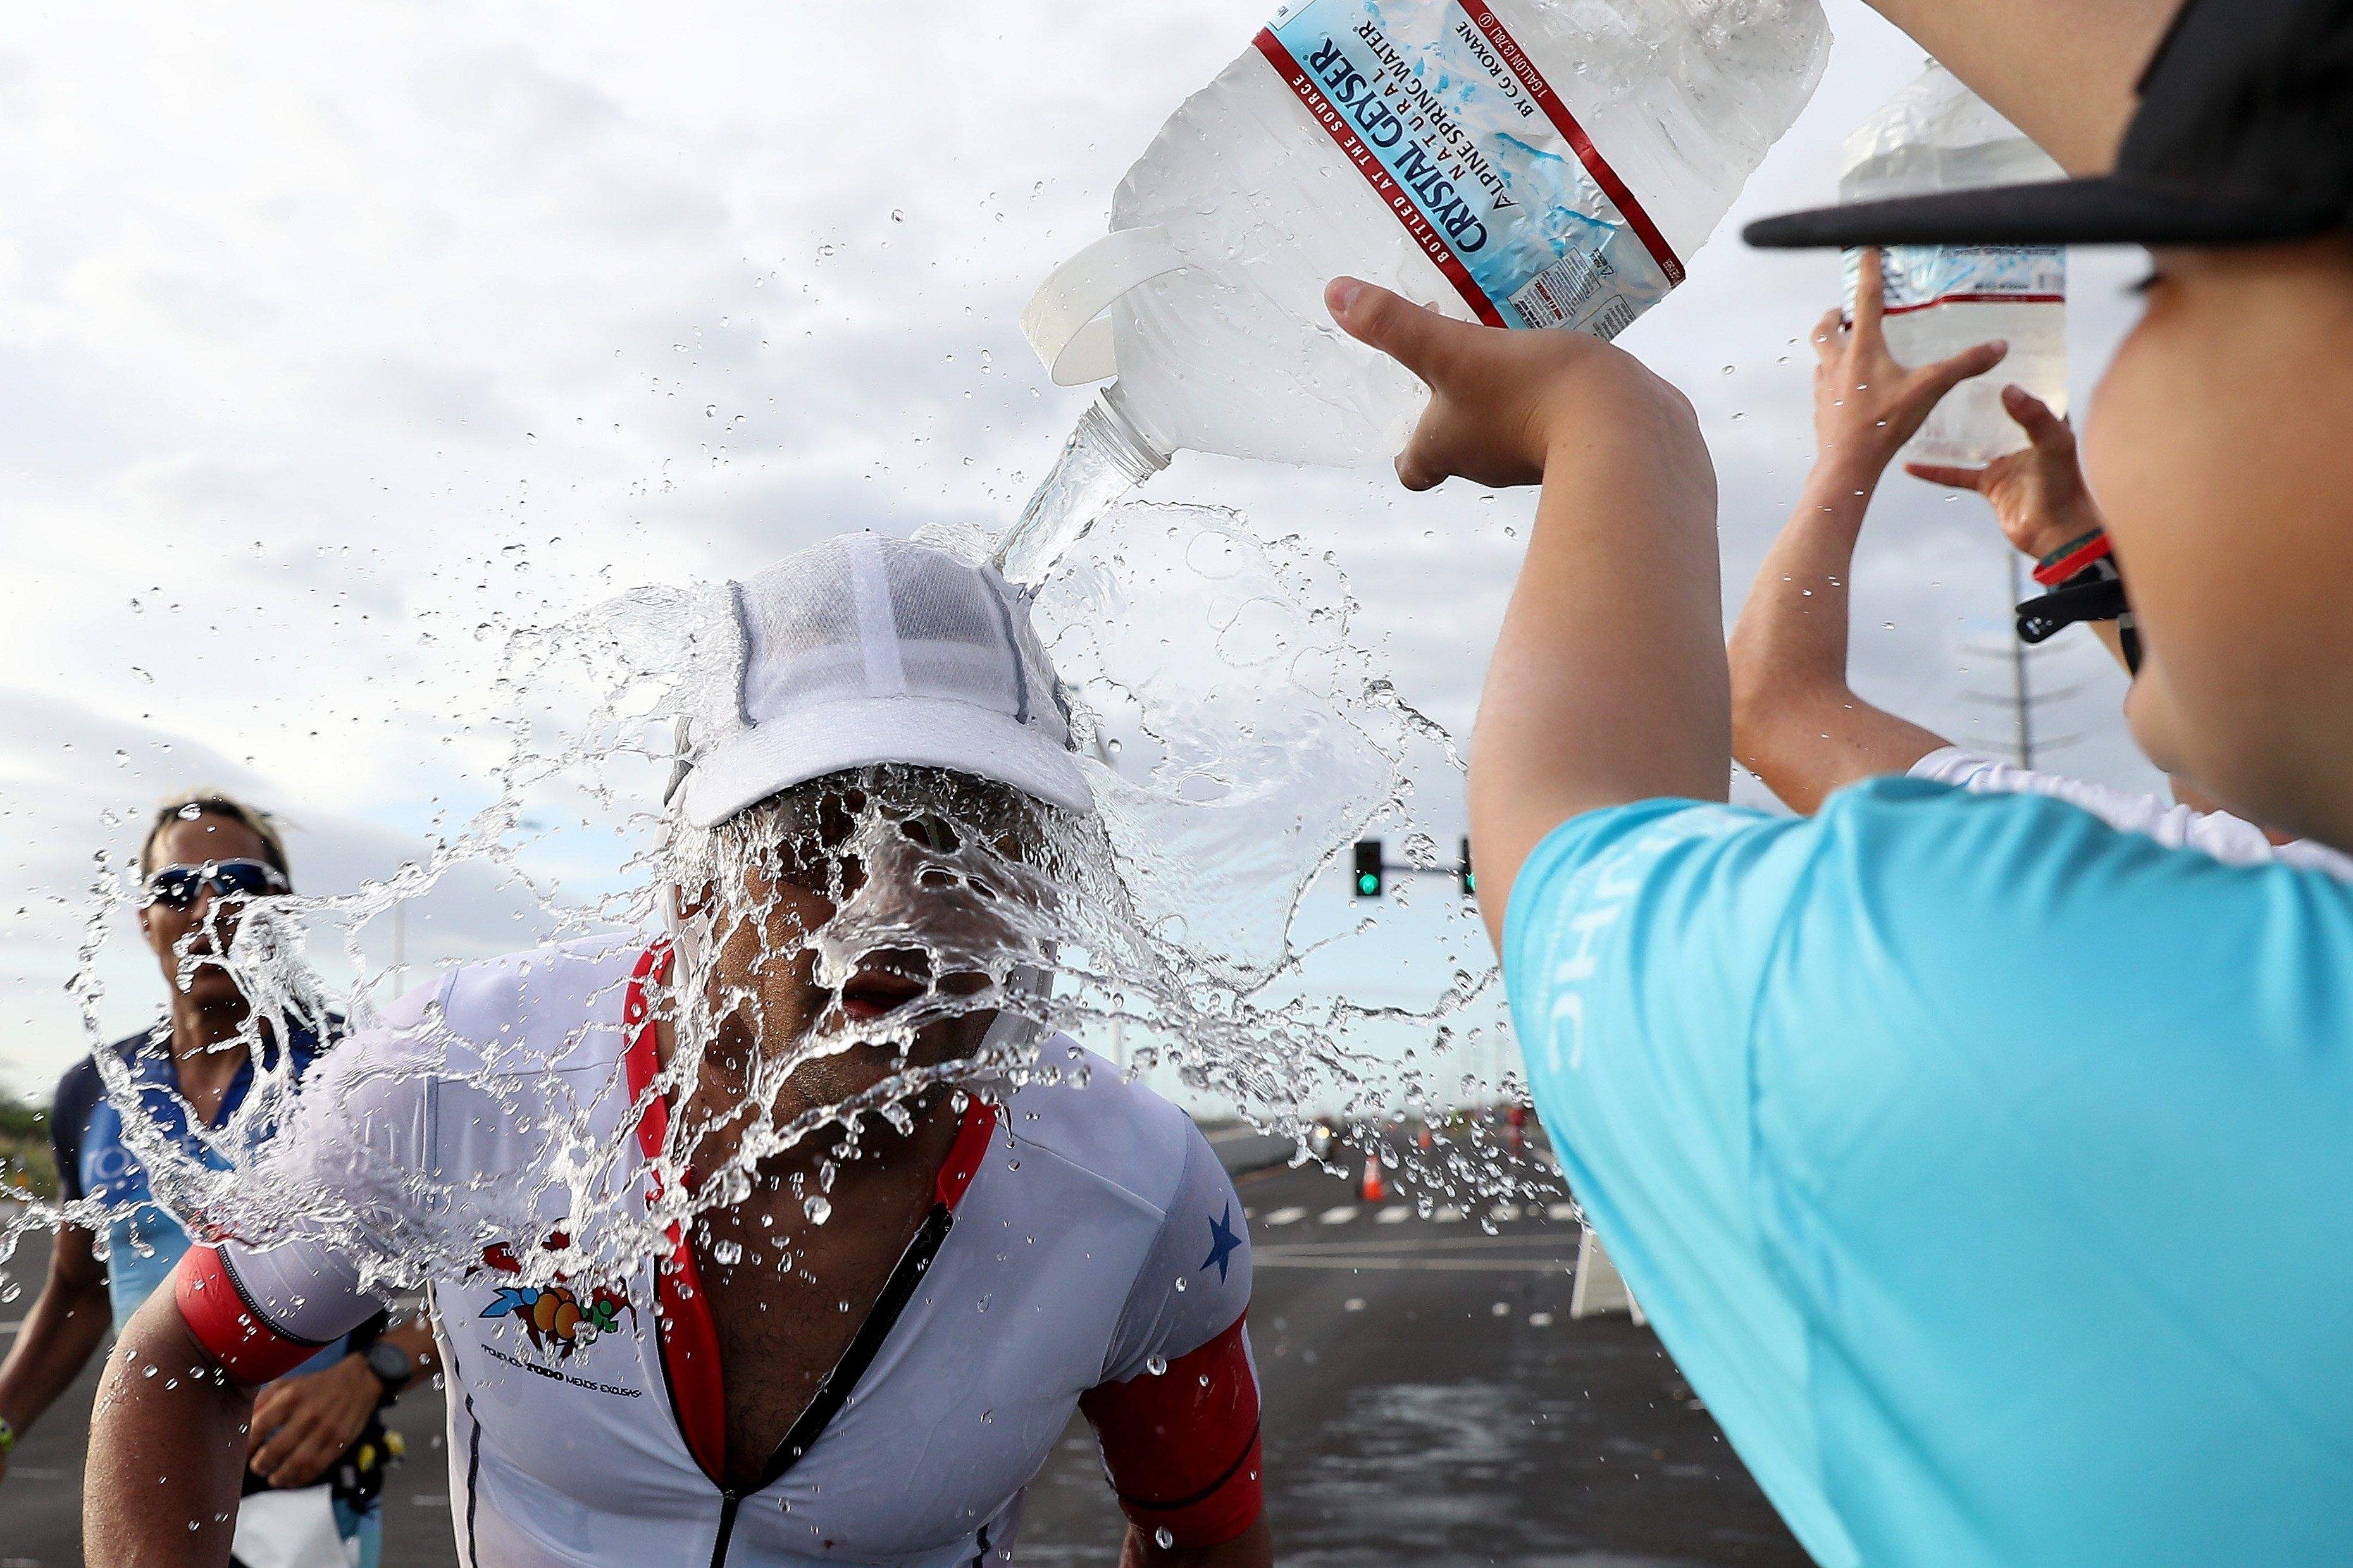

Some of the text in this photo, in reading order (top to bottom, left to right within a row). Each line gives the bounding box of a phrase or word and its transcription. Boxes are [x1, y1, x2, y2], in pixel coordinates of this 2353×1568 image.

[1455, 20, 1534, 117] BY CG ROXANE
[1489, 26, 1517, 56] (3.78L)
[1510, 53, 1543, 91] GALLON
[1372, 68, 1466, 180] NATURAL
[1404, 77, 1464, 144] SPRING
[1537, 89, 1547, 97] 1
[1293, 74, 1449, 262] BOTTLED AT THE SOURCE
[1393, 139, 1487, 254] CRYSTAL
[1447, 140, 1518, 209] ALPINE
[526, 1362, 564, 1381] TODO
[566, 1375, 598, 1391] MENOS
